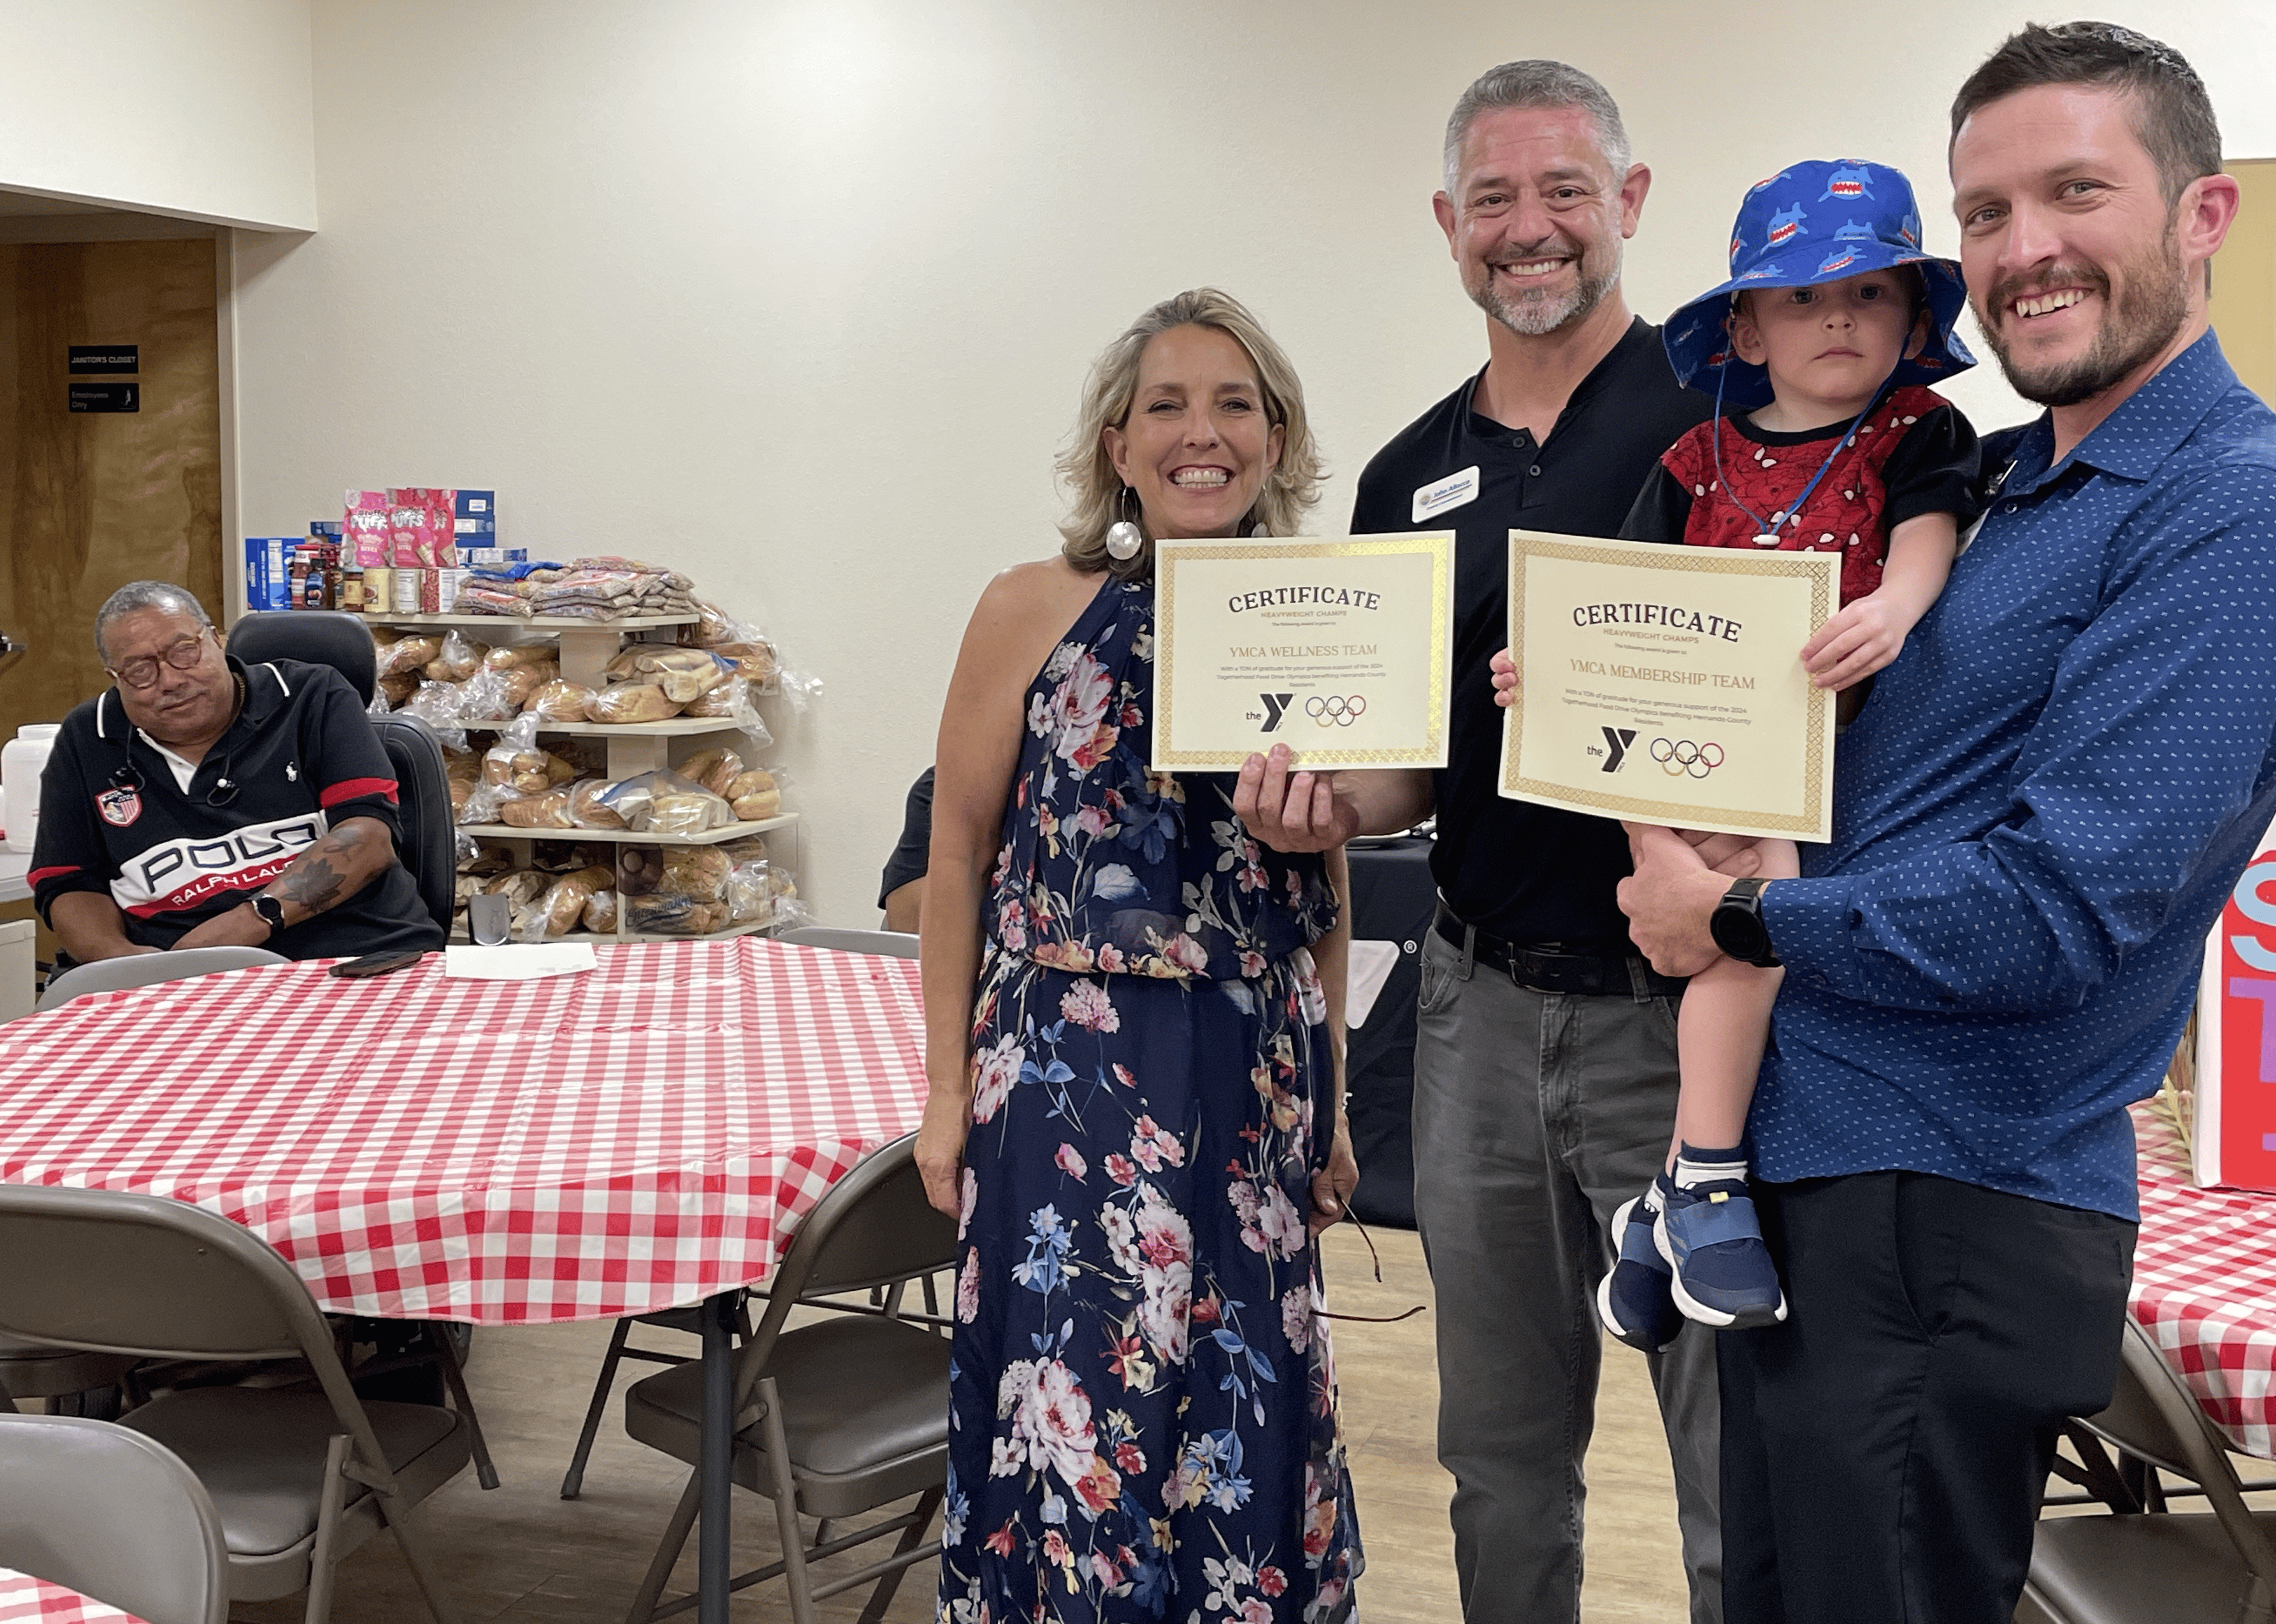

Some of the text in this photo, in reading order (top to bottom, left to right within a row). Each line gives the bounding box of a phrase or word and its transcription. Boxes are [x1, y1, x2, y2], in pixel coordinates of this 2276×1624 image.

[1229, 587, 1381, 612] CERTIFICATE
[1573, 603, 1742, 643] CERTIFICATE
[1603, 628, 1700, 644] HEAVYWEIGHT CHAMPS
[1230, 644, 1377, 657] YMCA WELLNESS TEAM
[1570, 658, 1755, 690] YMCA MEMBERSHIP TEAM
[1246, 711, 1262, 720] the
[1587, 745, 1603, 757] the
[140, 822, 317, 894] POLO
[171, 876, 239, 906] RALPH
